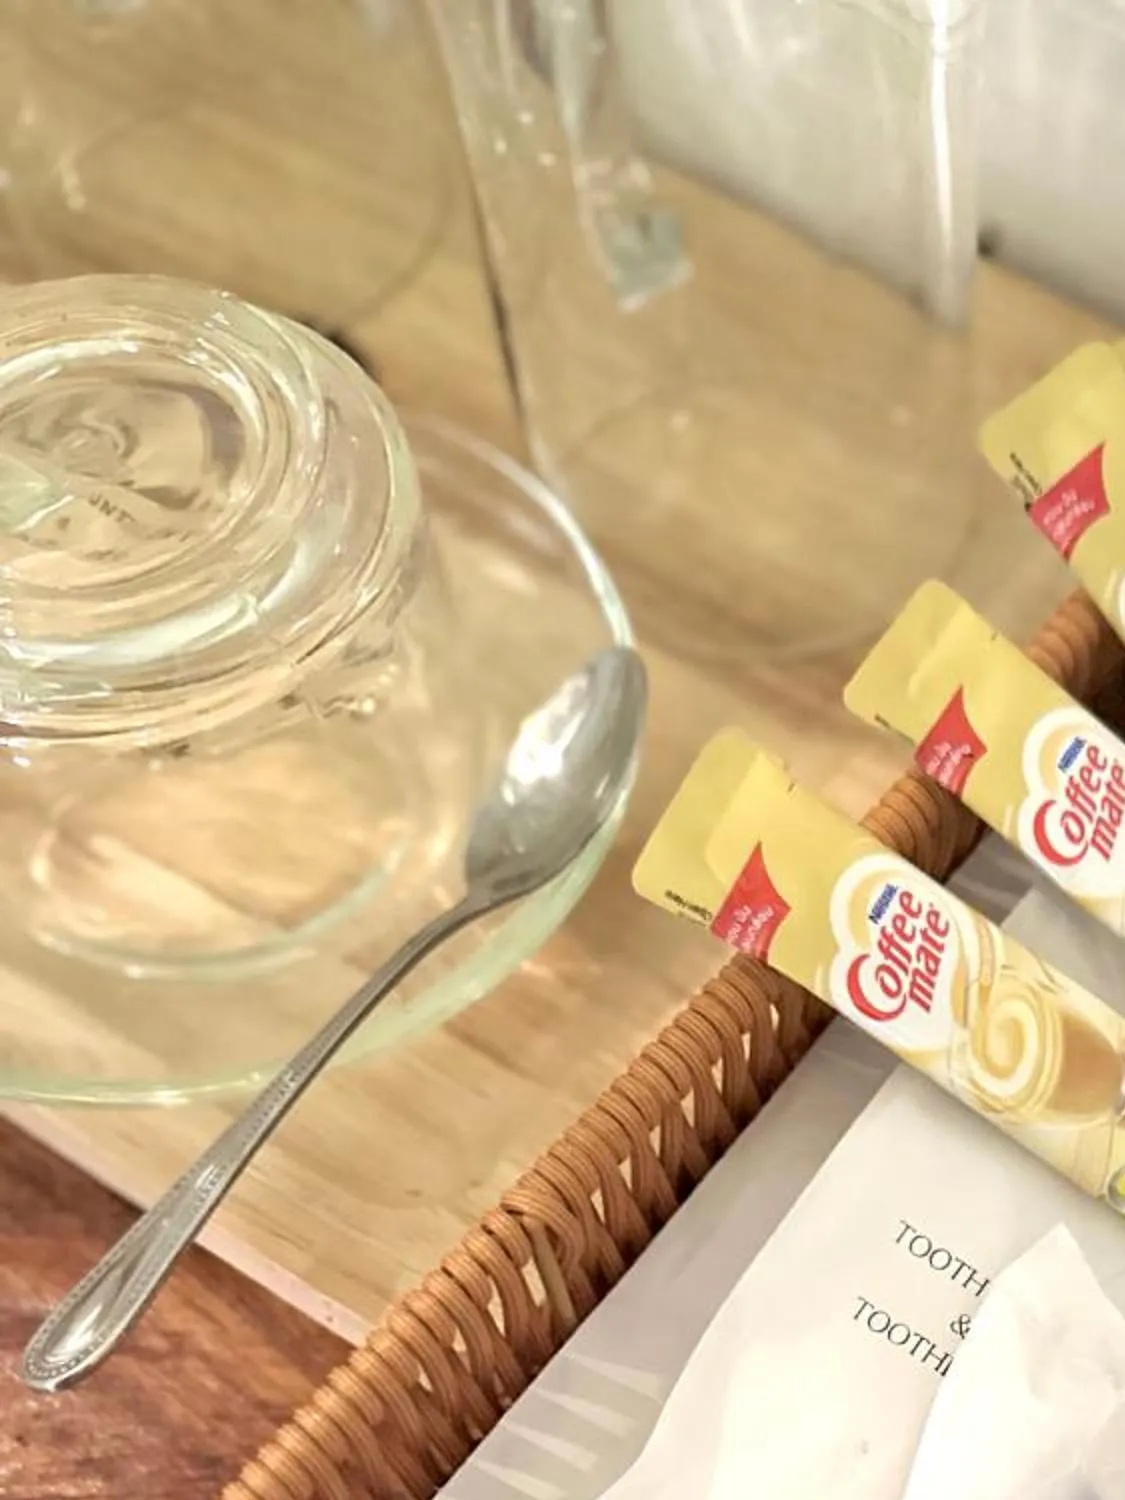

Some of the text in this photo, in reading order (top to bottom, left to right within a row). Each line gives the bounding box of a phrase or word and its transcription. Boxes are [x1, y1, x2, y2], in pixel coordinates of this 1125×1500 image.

[1033, 745, 1107, 867] Coffee
[846, 891, 922, 1021] Coffee
[907, 909, 950, 1014] mate
[853, 1295, 955, 1378] TOOTH
[949, 1312, 972, 1341] &
